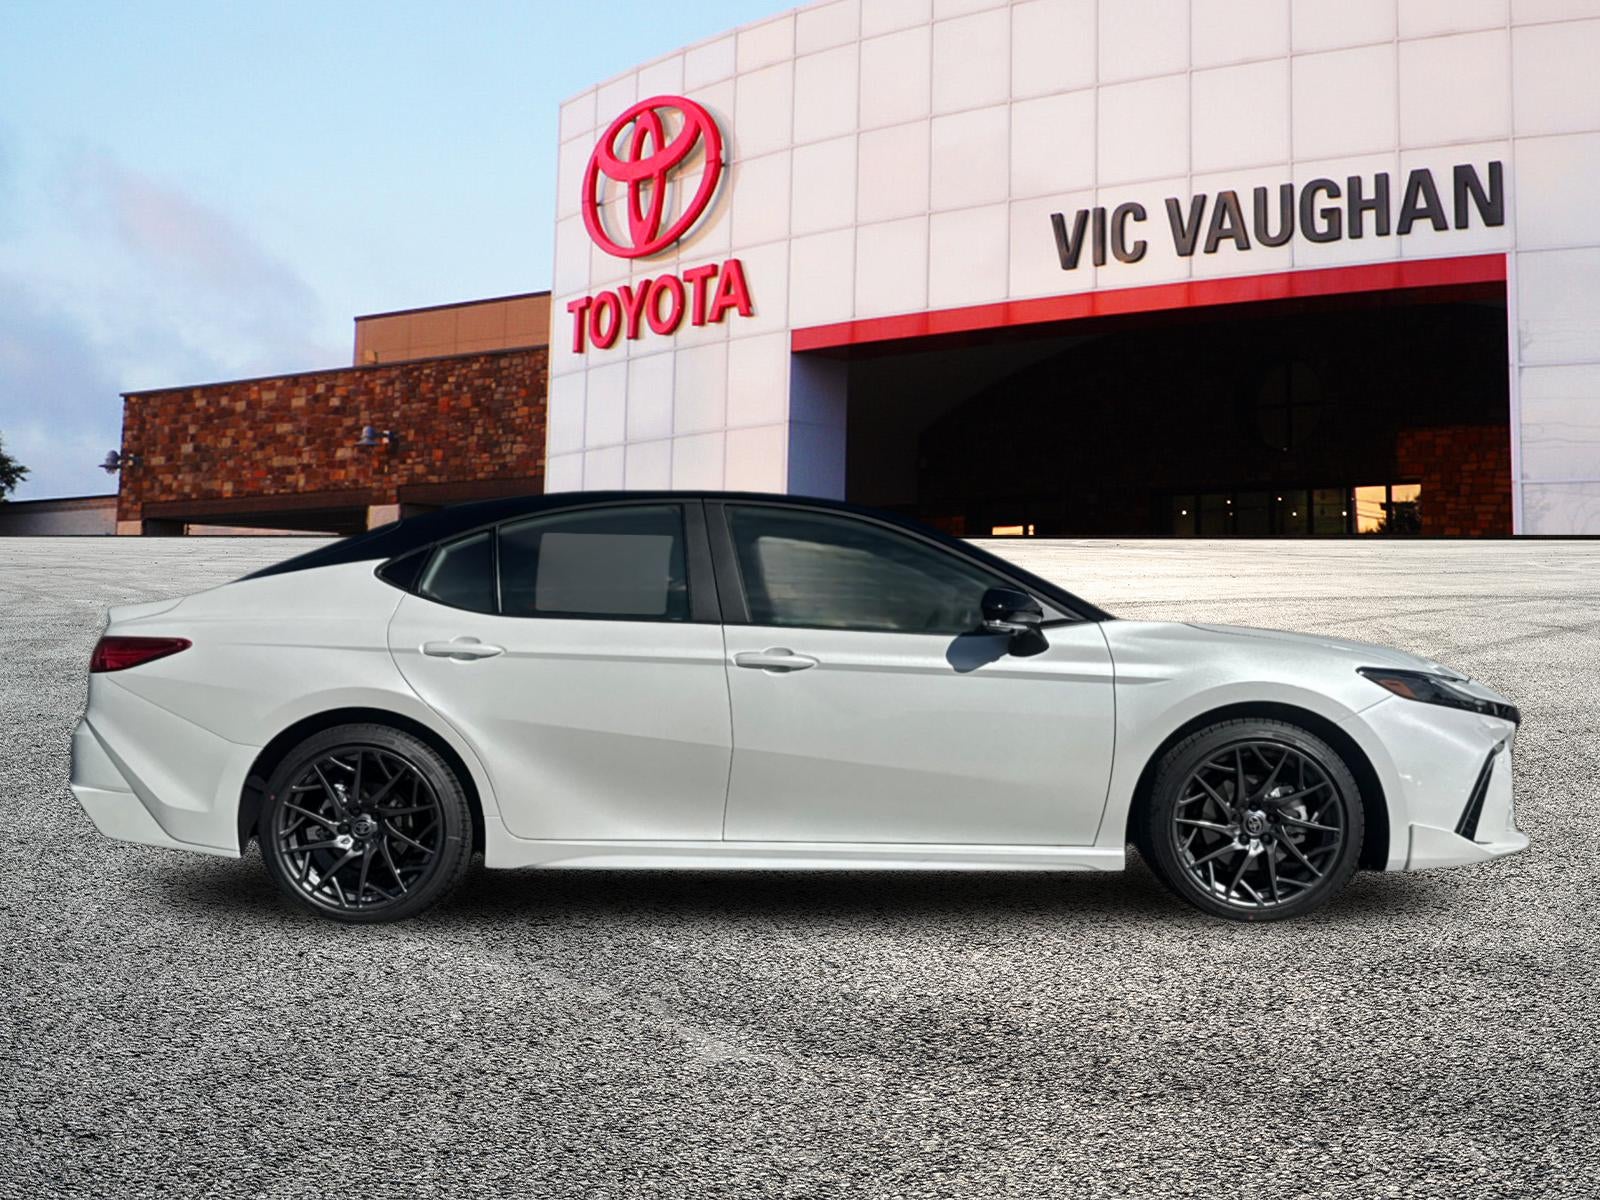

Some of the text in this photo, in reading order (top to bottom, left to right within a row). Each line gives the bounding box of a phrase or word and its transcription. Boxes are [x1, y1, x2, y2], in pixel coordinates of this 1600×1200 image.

[1050, 160, 1505, 270] VIC VAUGHAN
[567, 258, 754, 354] TOYOTA
